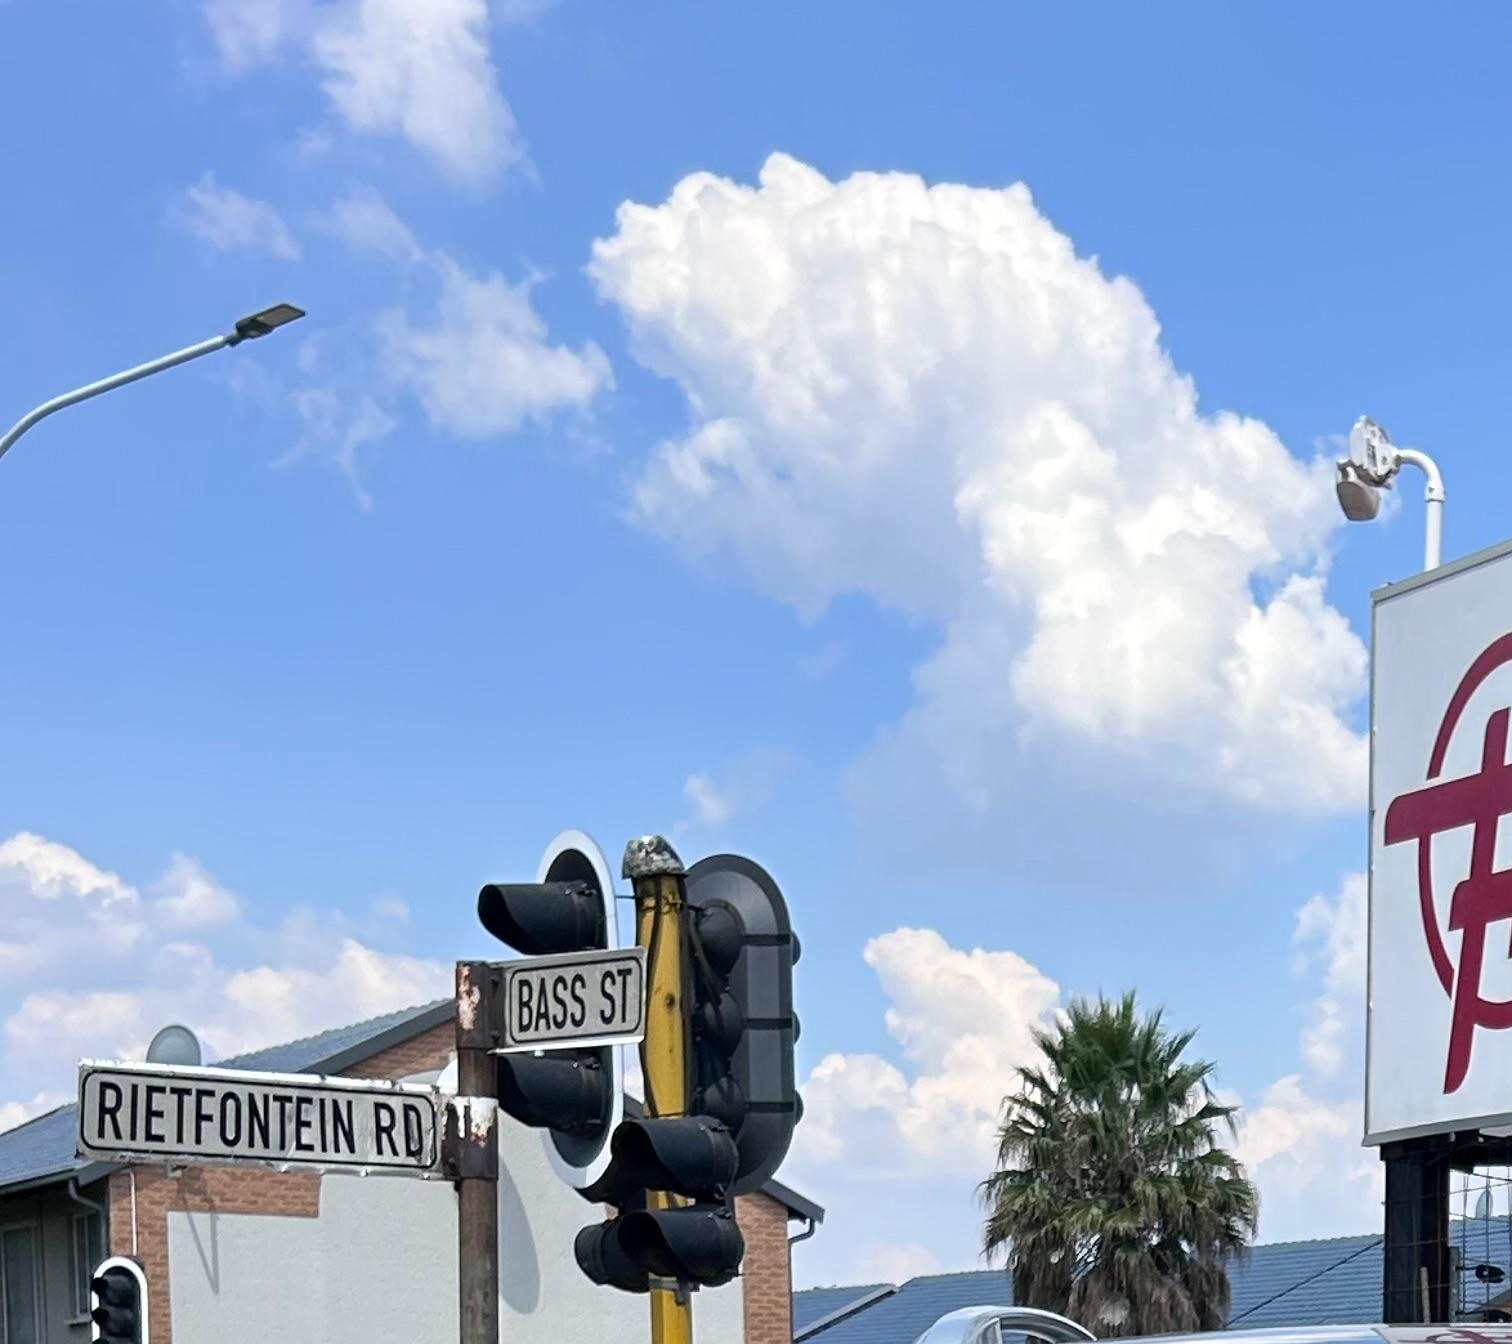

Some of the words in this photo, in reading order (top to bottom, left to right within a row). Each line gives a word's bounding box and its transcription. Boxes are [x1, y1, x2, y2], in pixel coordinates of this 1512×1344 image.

[518, 973, 587, 1033] BASS
[600, 968, 633, 1025] ST
[97, 1081, 356, 1154] RIETFONTEIN
[373, 1101, 424, 1159] RD
